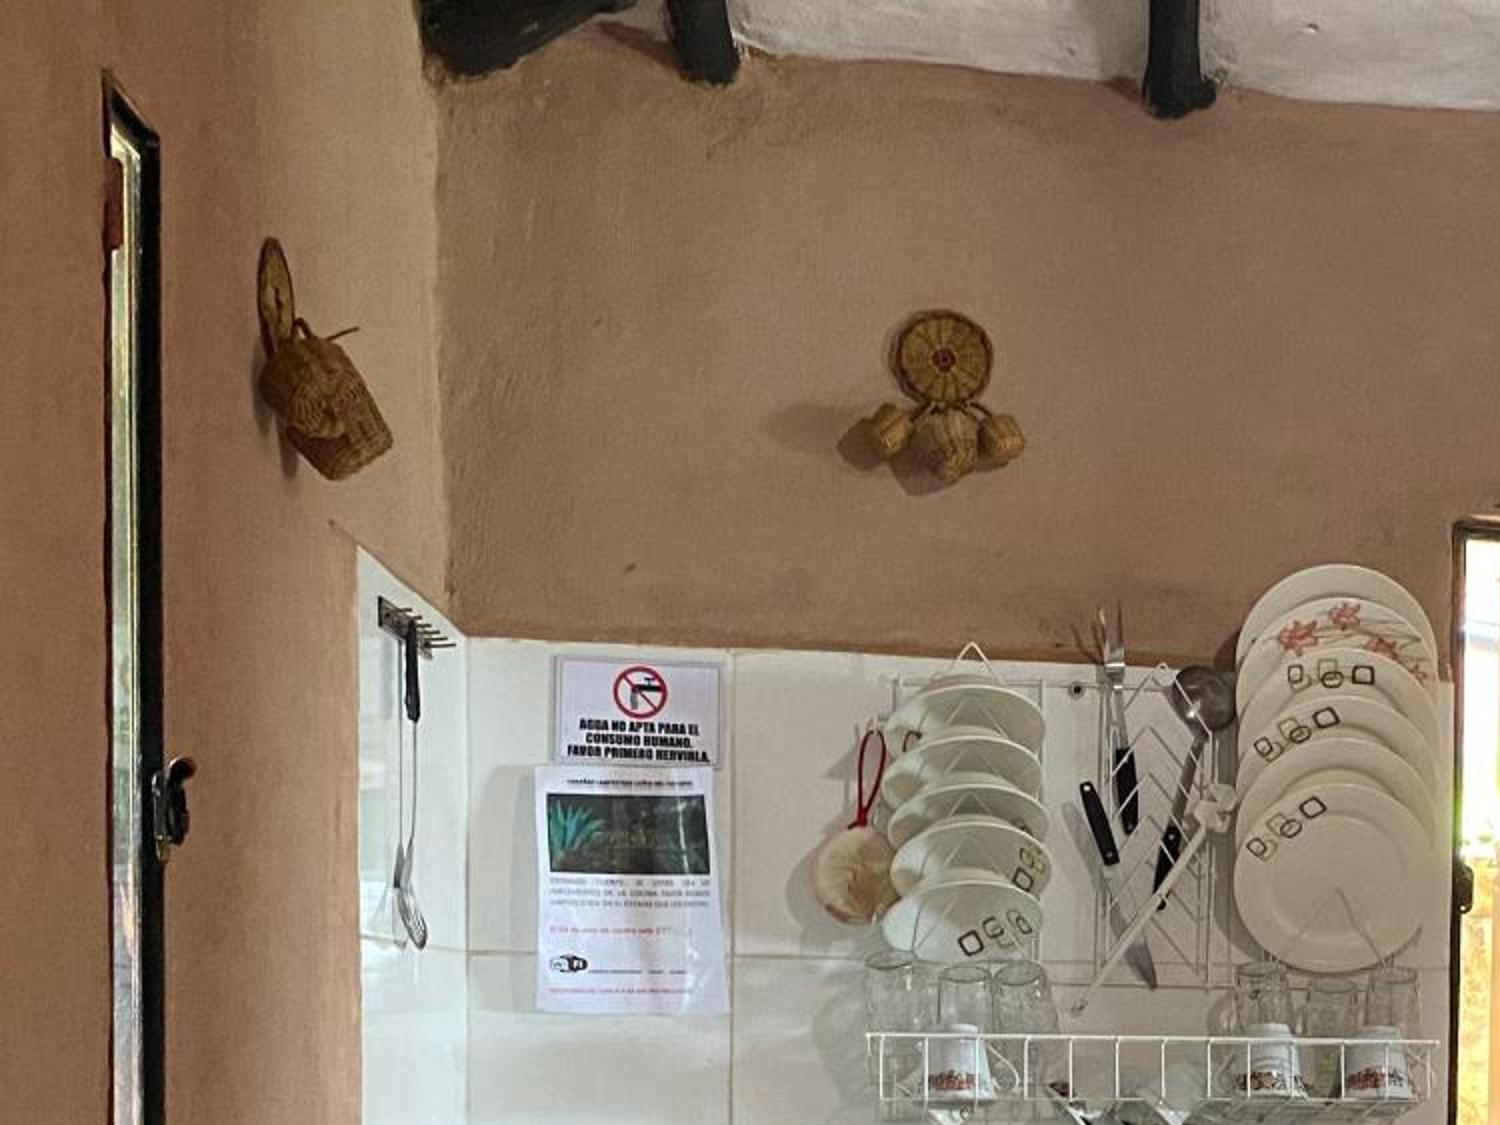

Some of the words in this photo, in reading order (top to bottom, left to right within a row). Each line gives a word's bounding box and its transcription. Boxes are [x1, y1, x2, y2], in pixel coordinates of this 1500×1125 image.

[579, 718, 609, 731] AGUA
[611, 720, 627, 732] NO
[628, 721, 656, 733] APTA
[657, 722, 687, 735] PARA
[688, 723, 700, 736] EL
[585, 732, 641, 746] CONSUMO
[567, 744, 601, 757] FAVOR
[603, 747, 653, 760] PRIMERO
